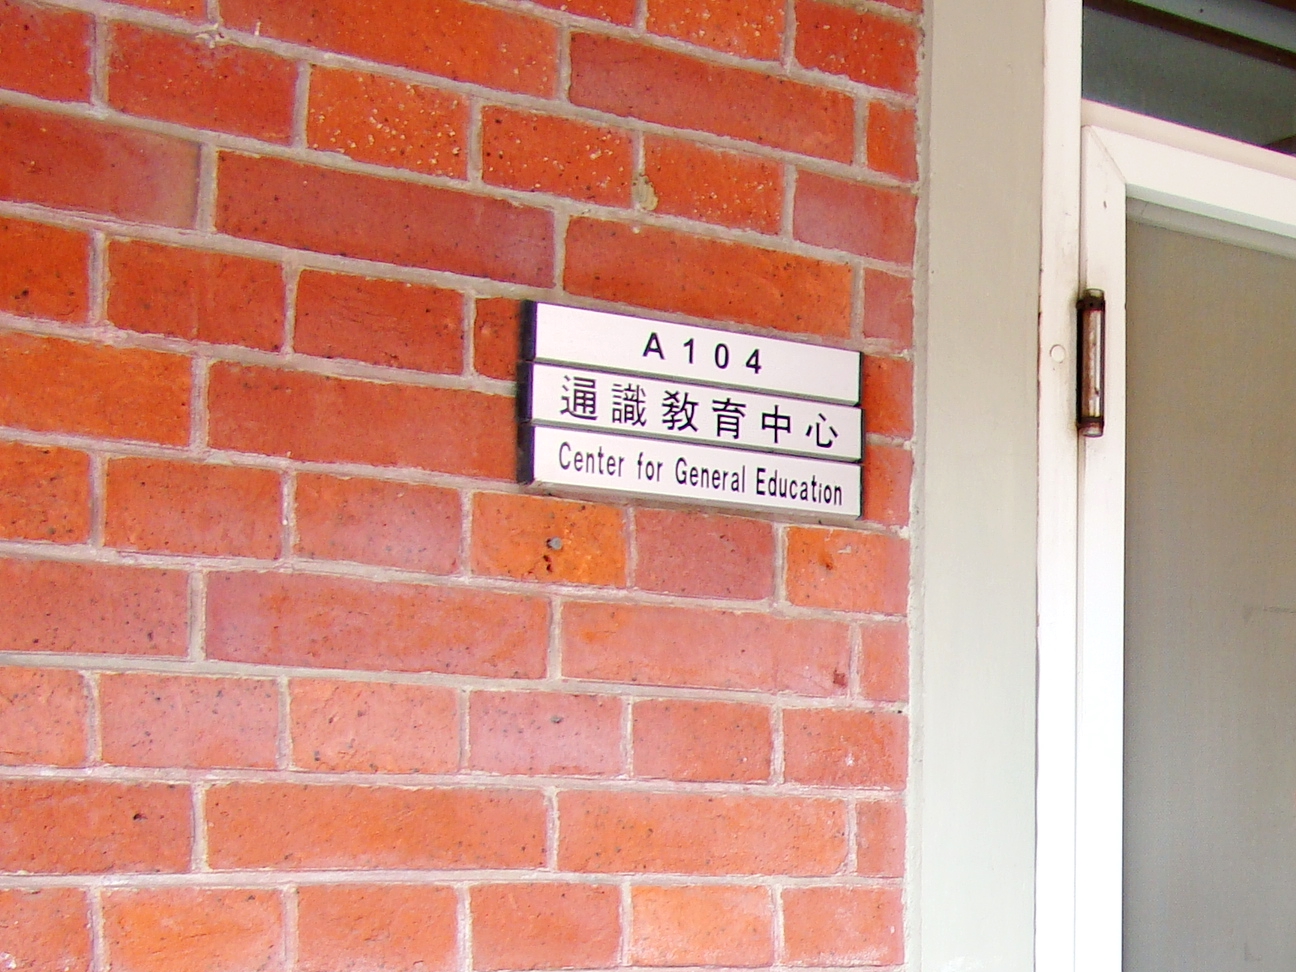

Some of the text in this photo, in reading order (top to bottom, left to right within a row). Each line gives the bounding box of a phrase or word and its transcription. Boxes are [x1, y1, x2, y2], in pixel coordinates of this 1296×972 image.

[559, 441, 843, 506] Center for General Education
